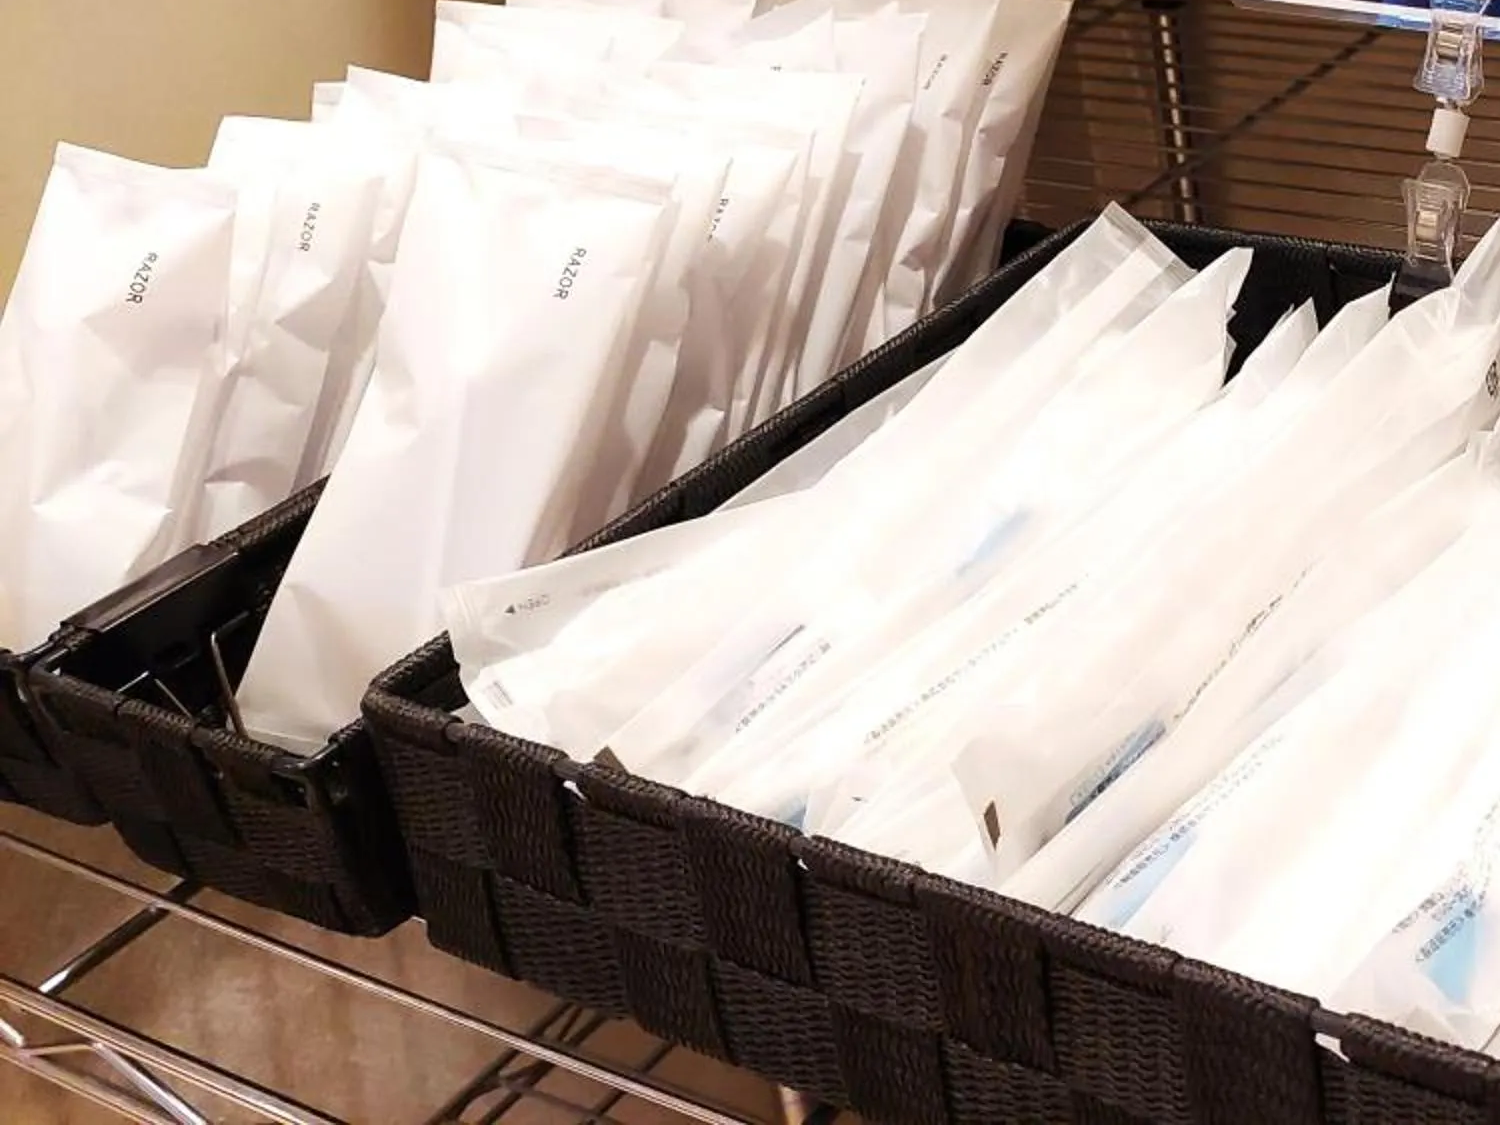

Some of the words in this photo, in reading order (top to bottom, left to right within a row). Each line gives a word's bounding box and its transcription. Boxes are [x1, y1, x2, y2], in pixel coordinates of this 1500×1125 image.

[298, 201, 321, 253] RAZOR
[125, 251, 159, 305] RAZOR
[552, 247, 587, 300] RAZOR
